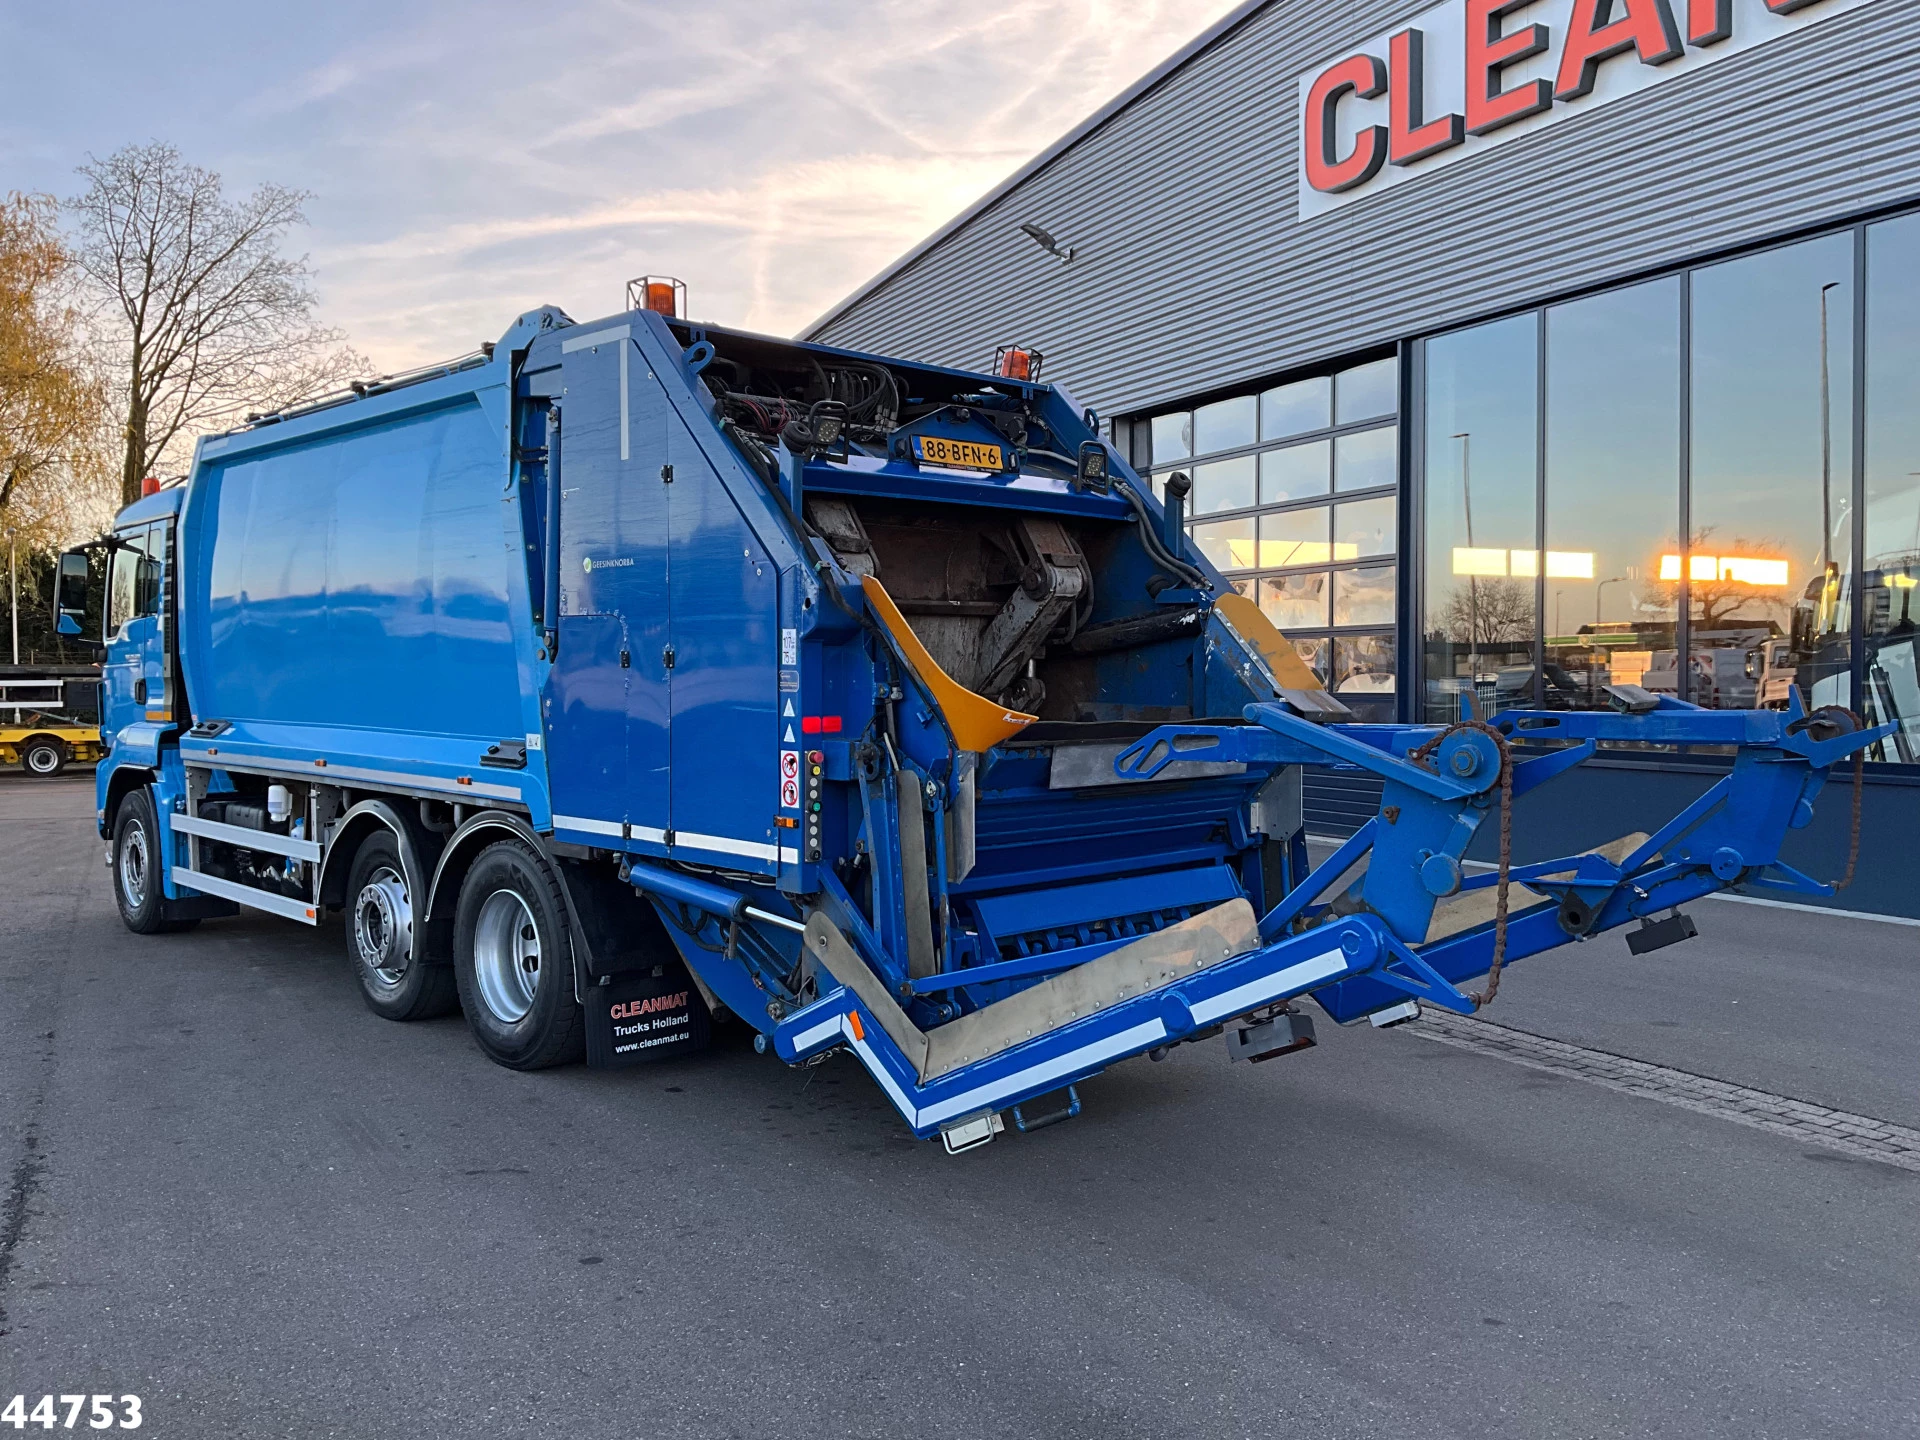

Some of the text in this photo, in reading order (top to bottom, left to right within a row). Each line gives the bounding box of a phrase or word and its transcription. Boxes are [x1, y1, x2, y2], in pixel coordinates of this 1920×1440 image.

[1304, 0, 1824, 193] CLEA
[926, 440, 997, 465] 88-BFN-6
[592, 558, 634, 569] GEESINKNORBA
[610, 991, 688, 1020] CLEANMAT
[613, 1013, 689, 1037] Trucks Holland
[615, 1031, 690, 1054] www.cleanmat.eu
